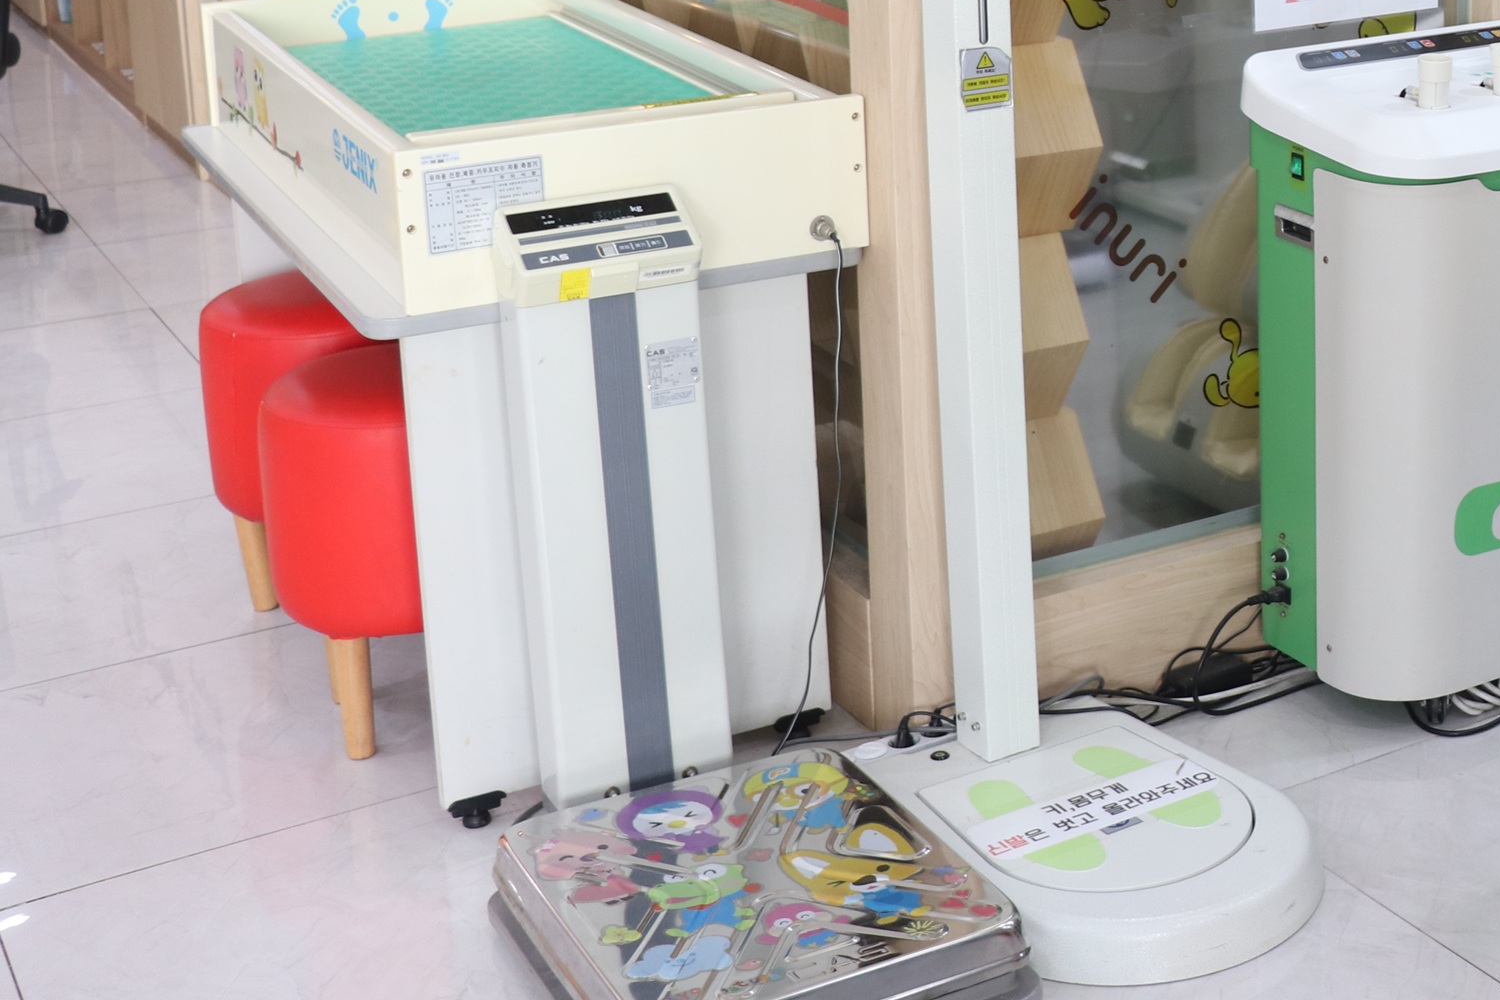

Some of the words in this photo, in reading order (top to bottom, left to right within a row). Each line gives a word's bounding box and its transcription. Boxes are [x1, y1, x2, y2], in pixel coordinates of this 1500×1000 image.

[342, 134, 377, 194] JENIX
[507, 163, 519, 171] 자동
[629, 205, 643, 213] kg
[1069, 174, 1187, 303] inuri
[539, 253, 569, 264] CAS
[646, 348, 665, 357] CAS
[1041, 782, 1129, 816] 키,몸무게
[987, 828, 1050, 856] 신발은
[1053, 811, 1099, 832] 벗고
[1101, 771, 1216, 816] 올라와주세요
